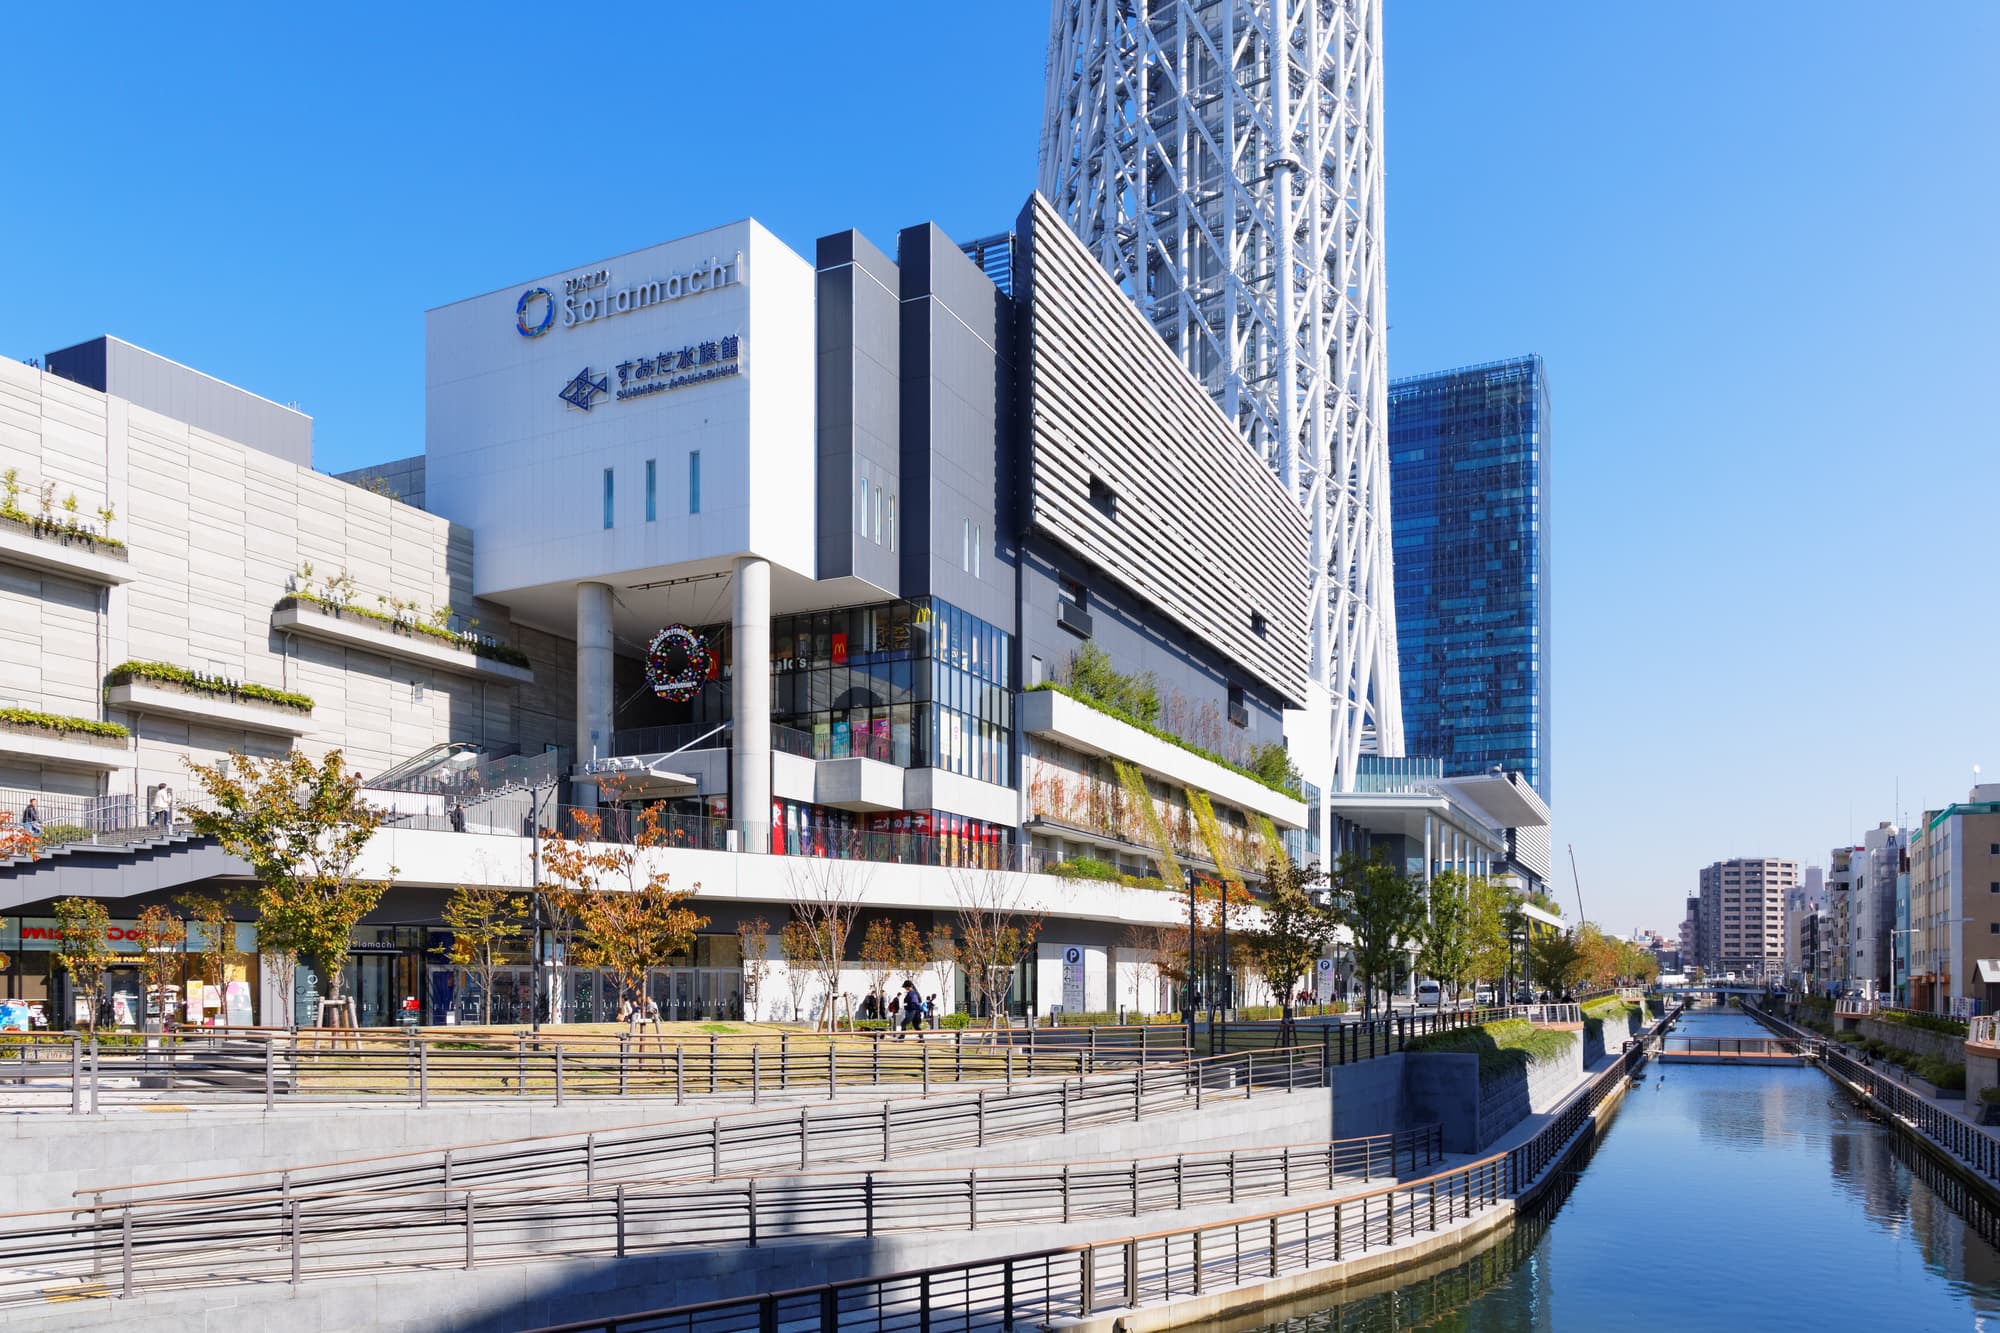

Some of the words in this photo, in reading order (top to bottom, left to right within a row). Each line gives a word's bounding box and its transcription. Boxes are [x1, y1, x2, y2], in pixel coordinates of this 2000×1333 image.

[563, 250, 743, 328] Solamachi
[564, 269, 609, 295] TOKYO
[615, 334, 740, 385] すみだ水族館
[616, 381, 665, 401] SUMIDA
[669, 362, 739, 390] AQUARIUM
